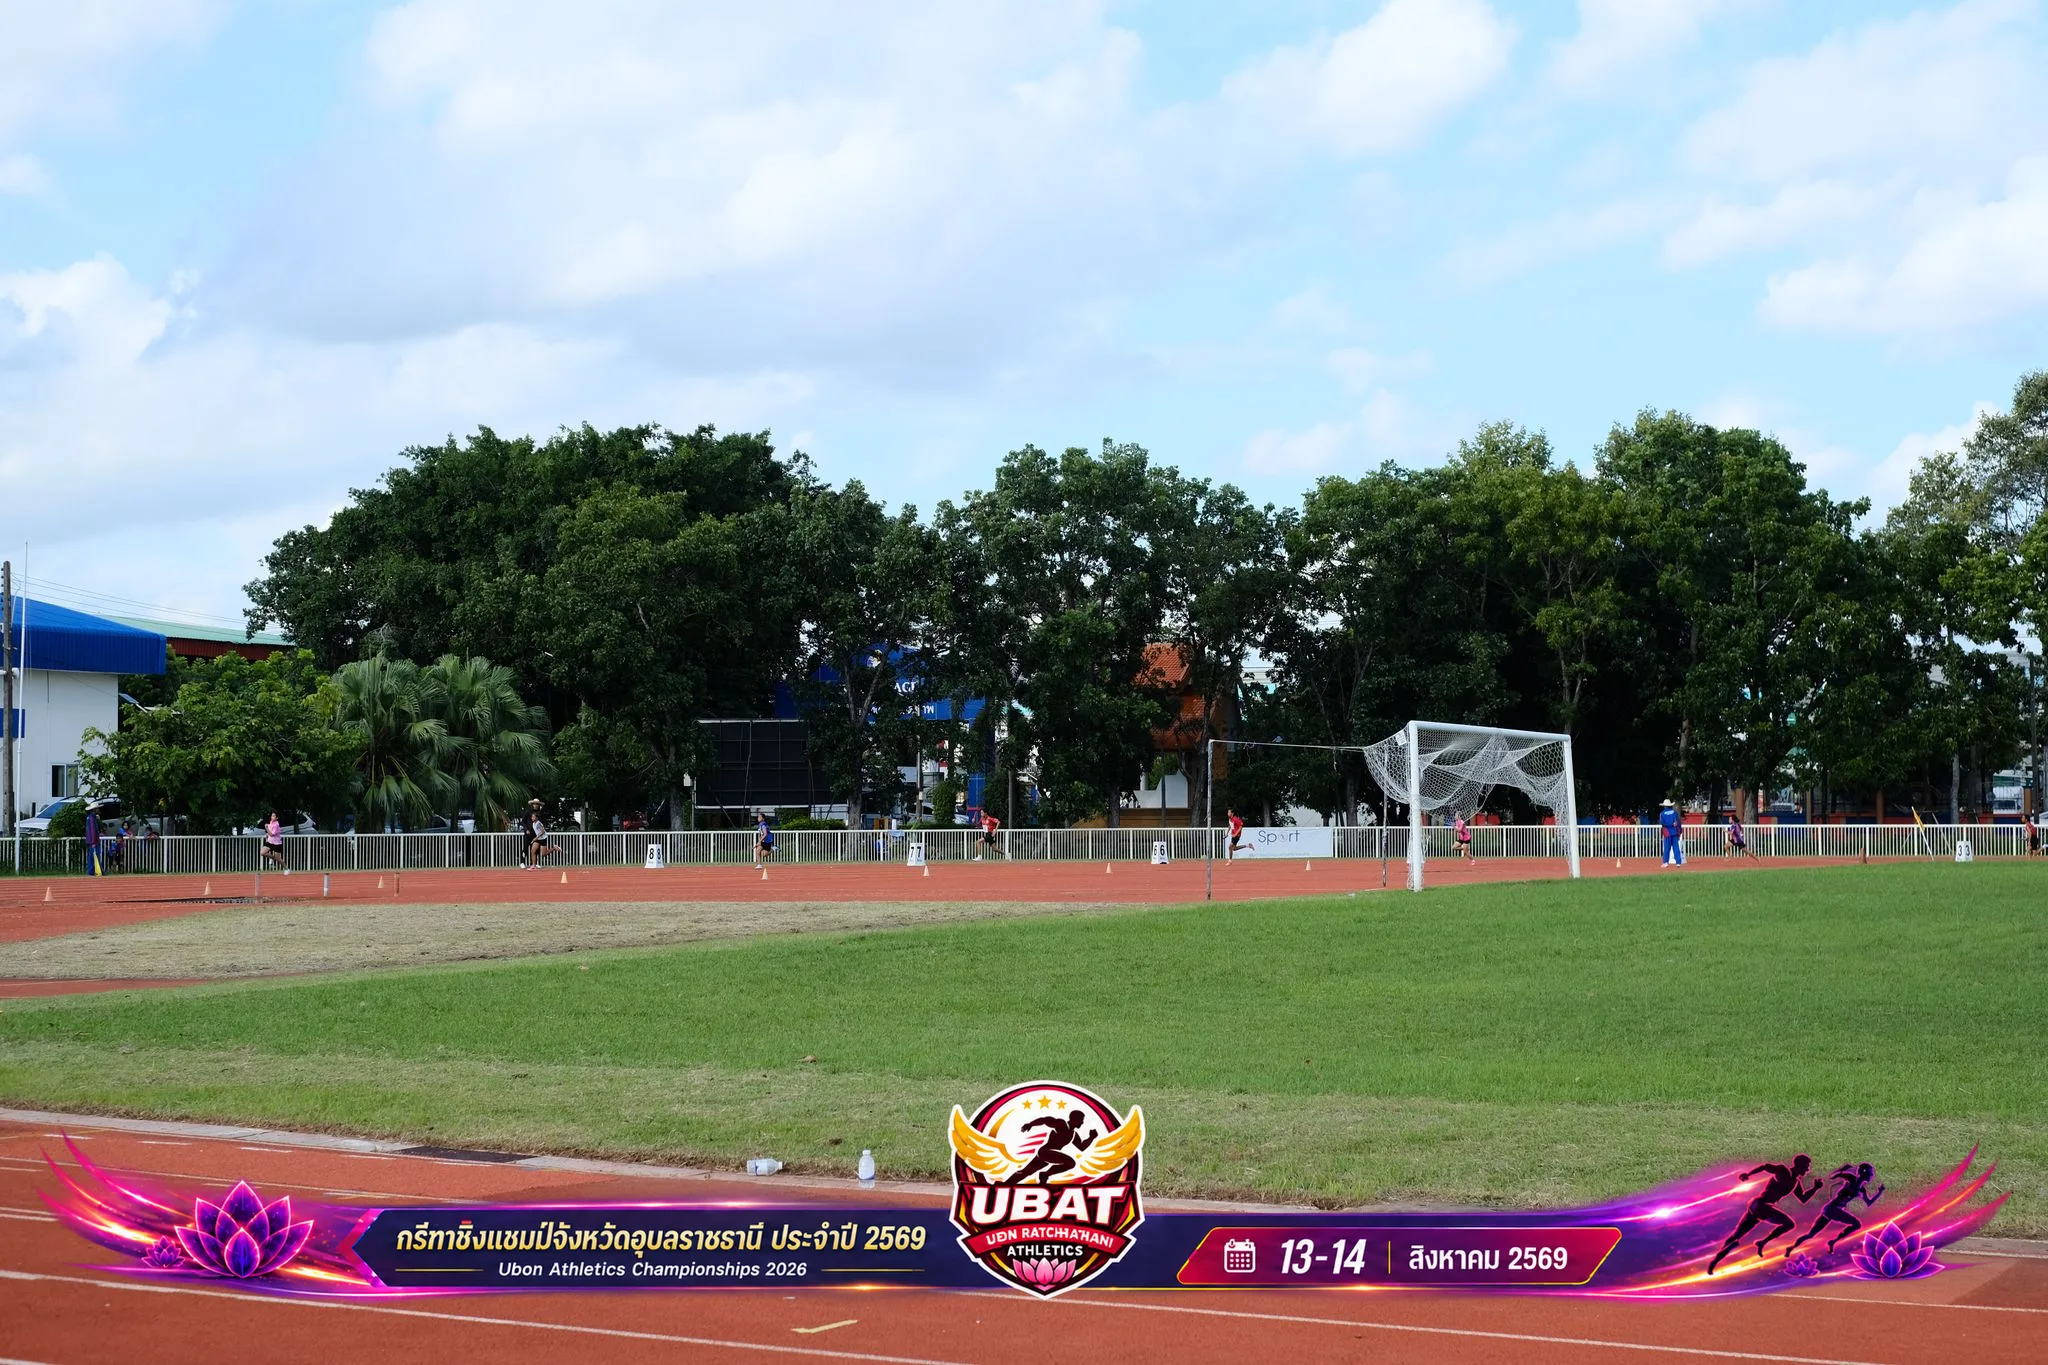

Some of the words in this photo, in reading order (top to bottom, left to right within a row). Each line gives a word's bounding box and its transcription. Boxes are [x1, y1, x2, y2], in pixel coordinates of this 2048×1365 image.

[649, 848, 654, 860] 8
[911, 846, 914, 858] 7
[916, 846, 921, 858] 7
[1160, 845, 1165, 856] 6
[1958, 845, 1962, 856] 3
[1965, 845, 1970, 856] 3
